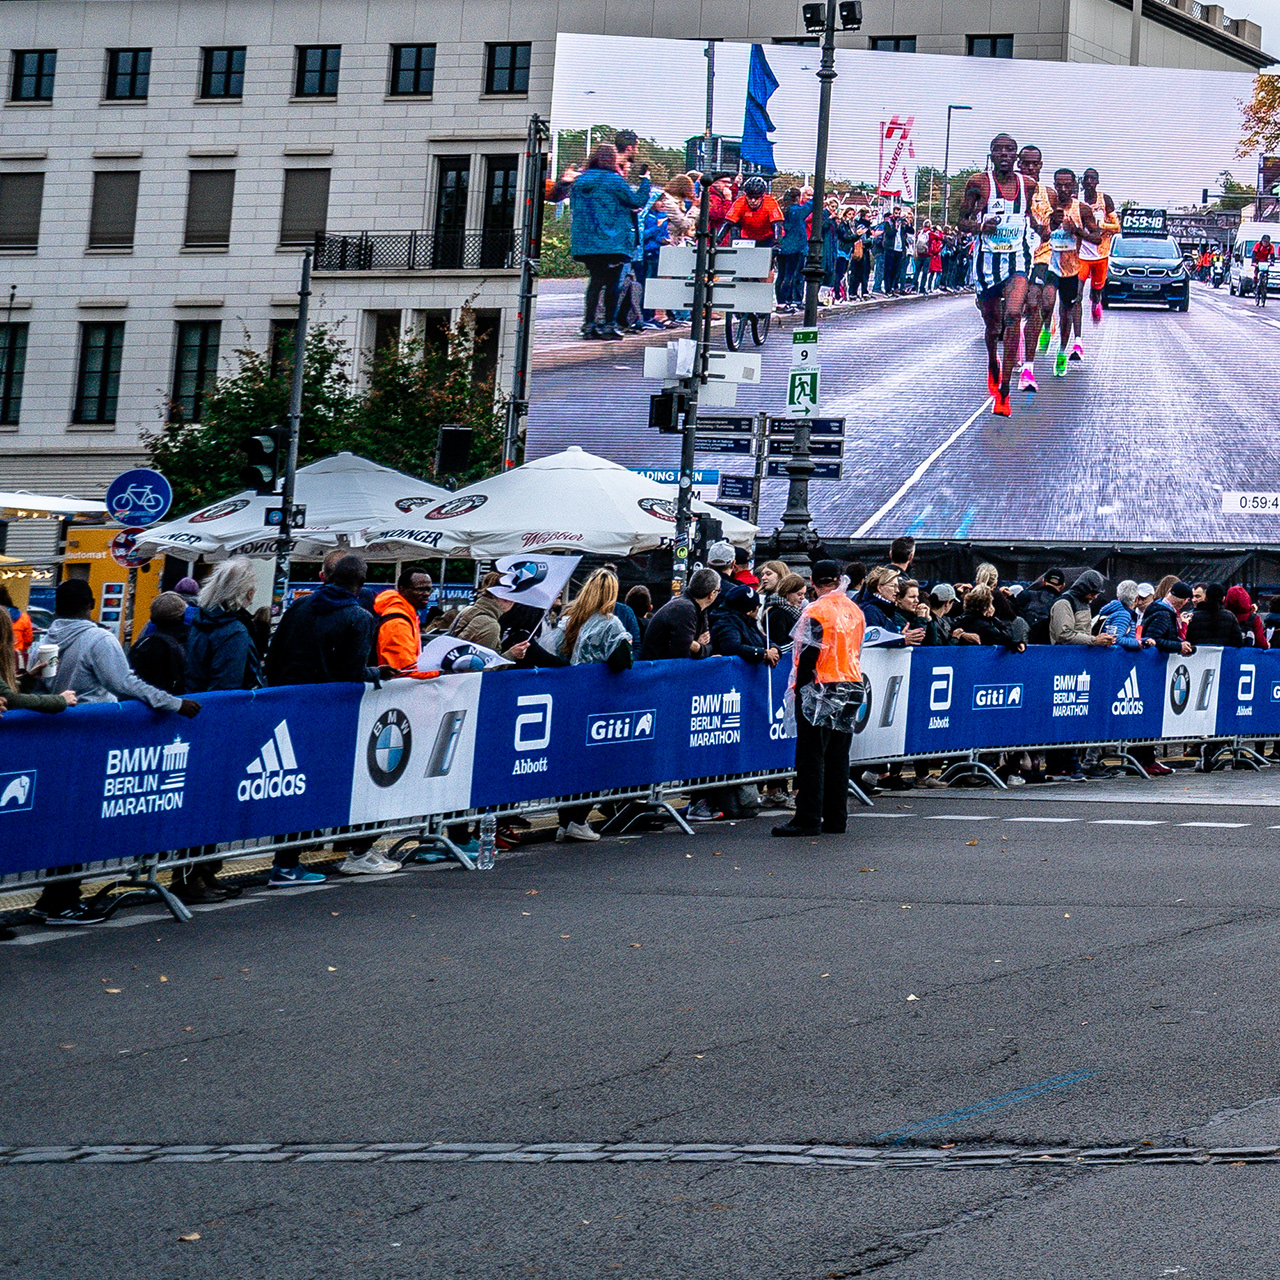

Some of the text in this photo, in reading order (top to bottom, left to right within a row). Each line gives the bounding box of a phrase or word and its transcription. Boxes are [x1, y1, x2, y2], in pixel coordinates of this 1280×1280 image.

[882, 141, 904, 188] HELLWEG
[801, 350, 808, 361] 9
[1053, 674, 1077, 691] BMW
[691, 694, 722, 715] BMW
[976, 688, 1004, 706] Giti
[1053, 692, 1076, 704] BERLIN
[1052, 704, 1089, 717] MARATHON
[1111, 697, 1144, 716] adidas
[1236, 705, 1253, 716] Abbott
[590, 717, 631, 740] Giti
[690, 715, 721, 731] BERLIN
[928, 716, 950, 730] Abbott
[689, 730, 741, 748] MARATHON
[106, 746, 162, 775] BMW
[512, 757, 548, 776] Abbott
[103, 774, 159, 797] BERLIN
[237, 770, 307, 802] adidas
[101, 791, 184, 819] MARATHON
